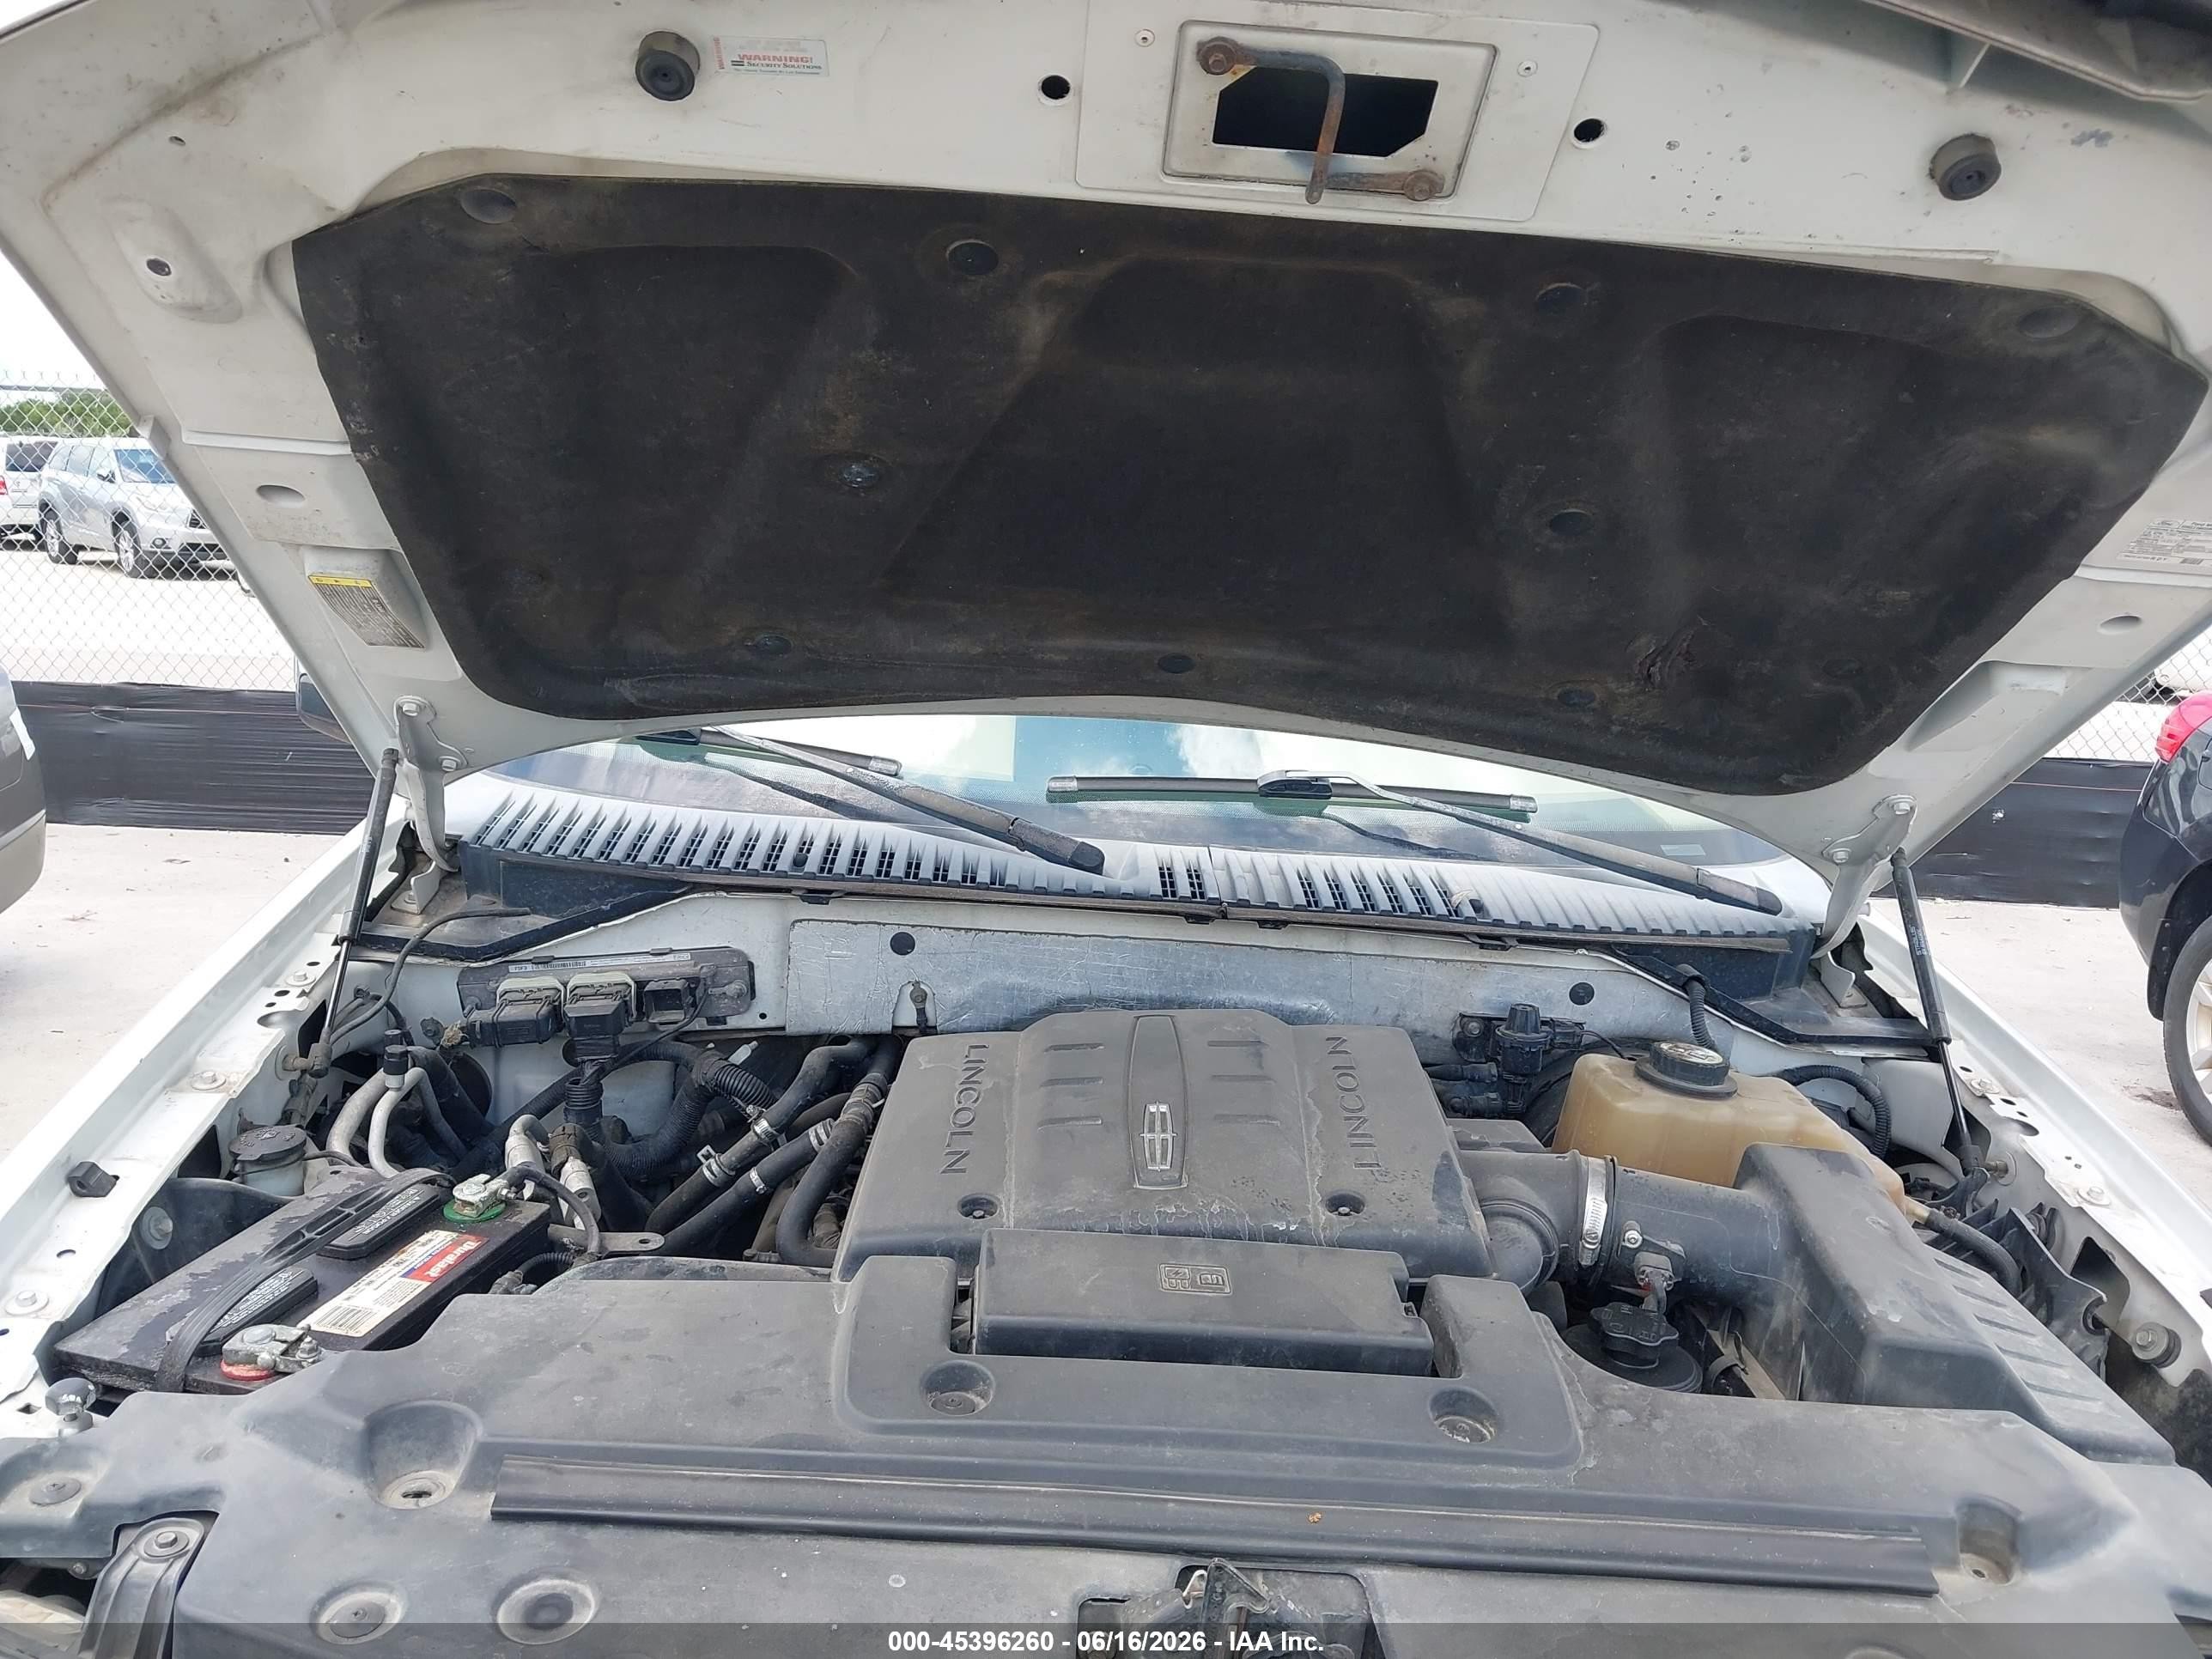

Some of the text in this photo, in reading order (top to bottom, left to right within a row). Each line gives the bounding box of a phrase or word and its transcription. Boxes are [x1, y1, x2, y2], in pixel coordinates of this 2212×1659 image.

[738, 54, 813, 64] WARNING!
[940, 1044, 989, 1175] LINCOLN
[1325, 1036, 1382, 1169] LINCOLN
[424, 1240, 482, 1278] Duralast
